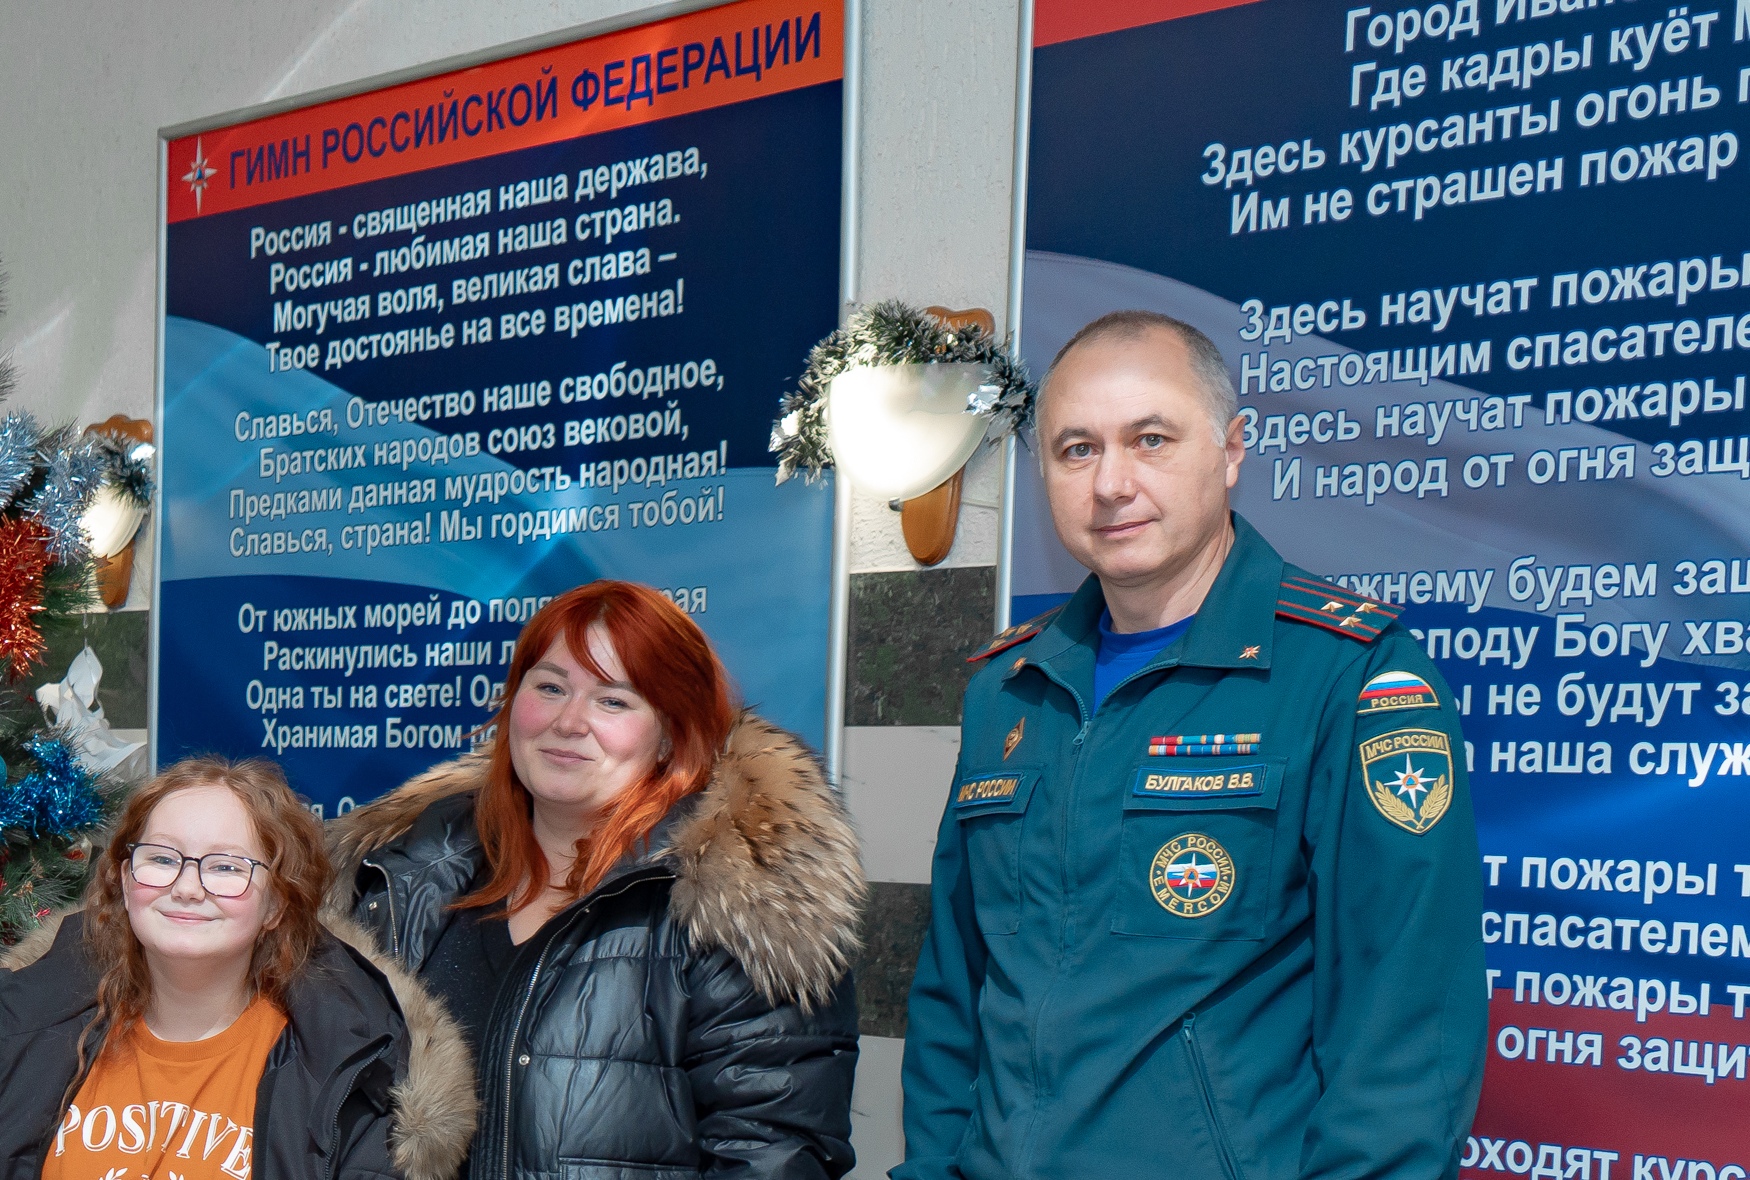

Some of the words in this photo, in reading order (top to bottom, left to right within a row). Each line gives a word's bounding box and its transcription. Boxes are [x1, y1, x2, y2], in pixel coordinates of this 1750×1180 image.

[1346, 0, 1479, 53] Город
[1351, 62, 1426, 111] Где
[1442, 35, 1592, 91] кадры
[1610, 7, 1718, 70] куёт
[230, 134, 311, 190] ГИМН
[321, 67, 559, 170] РОССИЙСКОЙ
[571, 11, 822, 108] ФЕДЕРАЦИИ
[1202, 139, 1326, 189] Здесь
[1340, 100, 1559, 172] курсанты
[1576, 76, 1720, 127] огонь
[251, 221, 331, 259] Россия
[354, 189, 491, 239] священная
[500, 174, 568, 211] наша
[576, 147, 707, 203] держава,
[1231, 192, 1289, 235] Им
[1304, 189, 1353, 225] не
[1367, 158, 1563, 220] страшен
[1580, 133, 1738, 186] пожар
[271, 258, 352, 294] Россия
[374, 232, 489, 277] любимая
[498, 219, 567, 254] наша
[576, 199, 680, 244] страна.
[274, 295, 370, 334] Могучая
[378, 284, 443, 316] воля,
[452, 263, 559, 304] великая
[569, 248, 650, 286] слава
[1238, 299, 1366, 344] Здесь
[1381, 278, 1539, 332] научат
[1552, 253, 1750, 307] пожары
[266, 339, 320, 372] Твое
[325, 324, 455, 370] достоянье
[463, 317, 492, 345] на
[500, 310, 546, 340] все
[555, 278, 684, 338] времена!
[1242, 341, 1490, 393] Настоящим
[235, 409, 338, 441] Славься,
[347, 391, 476, 428] Отечество
[484, 381, 551, 412] наше
[560, 359, 724, 403] свободное,
[1241, 408, 1360, 452] Здесь
[1377, 395, 1531, 444] научат
[1546, 377, 1745, 426] пожары
[260, 445, 366, 483] Братских
[375, 433, 480, 470] народов
[488, 424, 555, 454] союз
[565, 400, 688, 446] вековой,
[230, 488, 341, 524] Предками
[349, 479, 435, 513] данная
[446, 466, 572, 507] мудрость
[580, 440, 727, 493] народная!
[1274, 459, 1300, 499] И
[1316, 460, 1448, 504] народ
[1464, 455, 1513, 487] от
[1528, 437, 1635, 483] огня
[230, 528, 333, 556] Славься,
[342, 512, 430, 555] страна!
[440, 510, 482, 541] Мы
[492, 489, 619, 544] гордимся
[629, 487, 724, 527] тобой!
[1509, 557, 1657, 611] будем
[239, 603, 267, 633] От
[274, 606, 357, 631] южных
[365, 594, 441, 634] морей
[448, 600, 481, 630] до
[1555, 615, 1669, 667] Богу
[1682, 622, 1750, 654] хв
[264, 641, 417, 677] Раскинулись
[426, 642, 491, 666] наши
[247, 680, 304, 714] Одна
[311, 687, 342, 708] ты
[350, 685, 377, 708] на
[385, 676, 461, 708] свете!
[1371, 694, 1424, 708] РОССИЯ
[1488, 684, 1541, 716] не
[1557, 672, 1701, 727] будут
[262, 719, 377, 755] Хранимая
[386, 718, 461, 748] Богом
[1365, 739, 1393, 759] МЧС
[1393, 734, 1444, 749] РОССИИ
[1491, 741, 1612, 774] наша
[975, 779, 1018, 798] РОССИИ
[1145, 774, 1225, 791] БУЛГАКОВ
[1227, 772, 1254, 788] В.В.
[1156, 842, 1181, 868] МЧС
[1187, 837, 1231, 875] РОССИИ
[1522, 857, 1717, 904] пожары
[1154, 876, 1230, 913] EMERCOM
[1514, 972, 1710, 1022] пожары
[1498, 1027, 1602, 1065] огня
[1618, 1037, 1750, 1083] защи
[55, 1101, 254, 1180] POSITIVE
